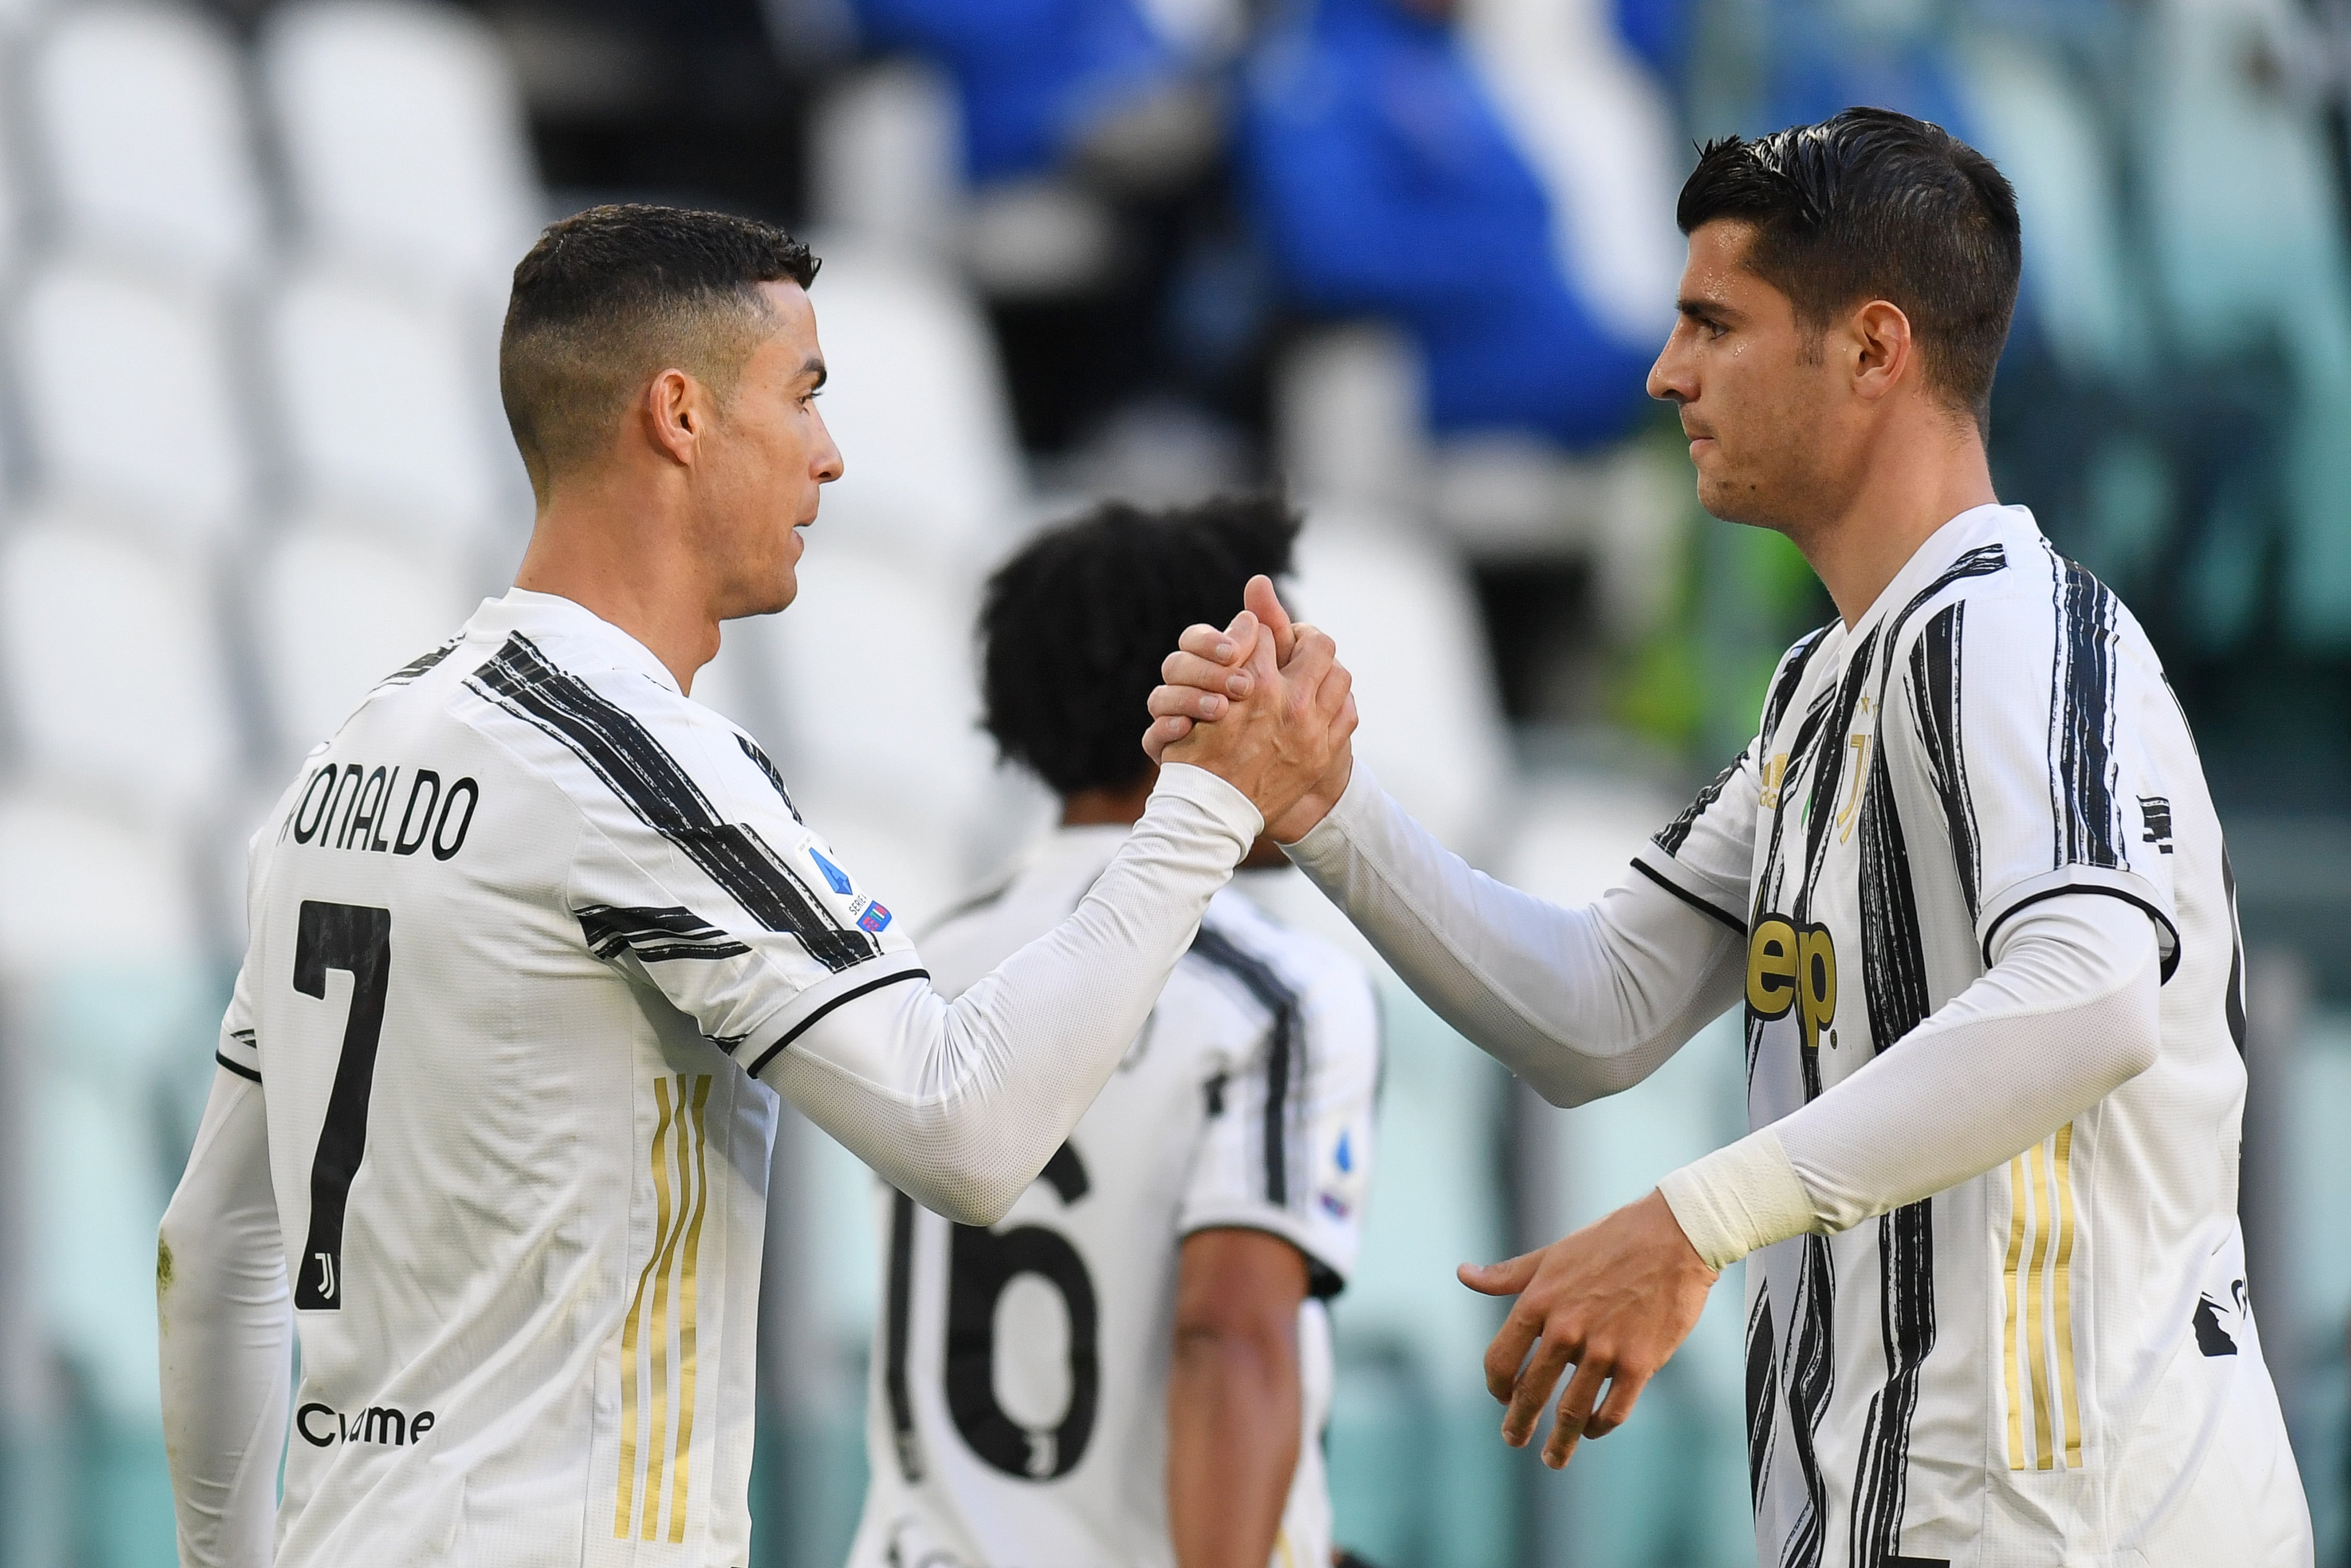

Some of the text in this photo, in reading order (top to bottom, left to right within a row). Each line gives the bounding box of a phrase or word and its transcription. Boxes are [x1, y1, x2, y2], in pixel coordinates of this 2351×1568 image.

[276, 763, 479, 861] ONALDO
[849, 895, 866, 915] SERIE
[1745, 917, 1837, 1049] ep
[293, 900, 392, 1310] 7
